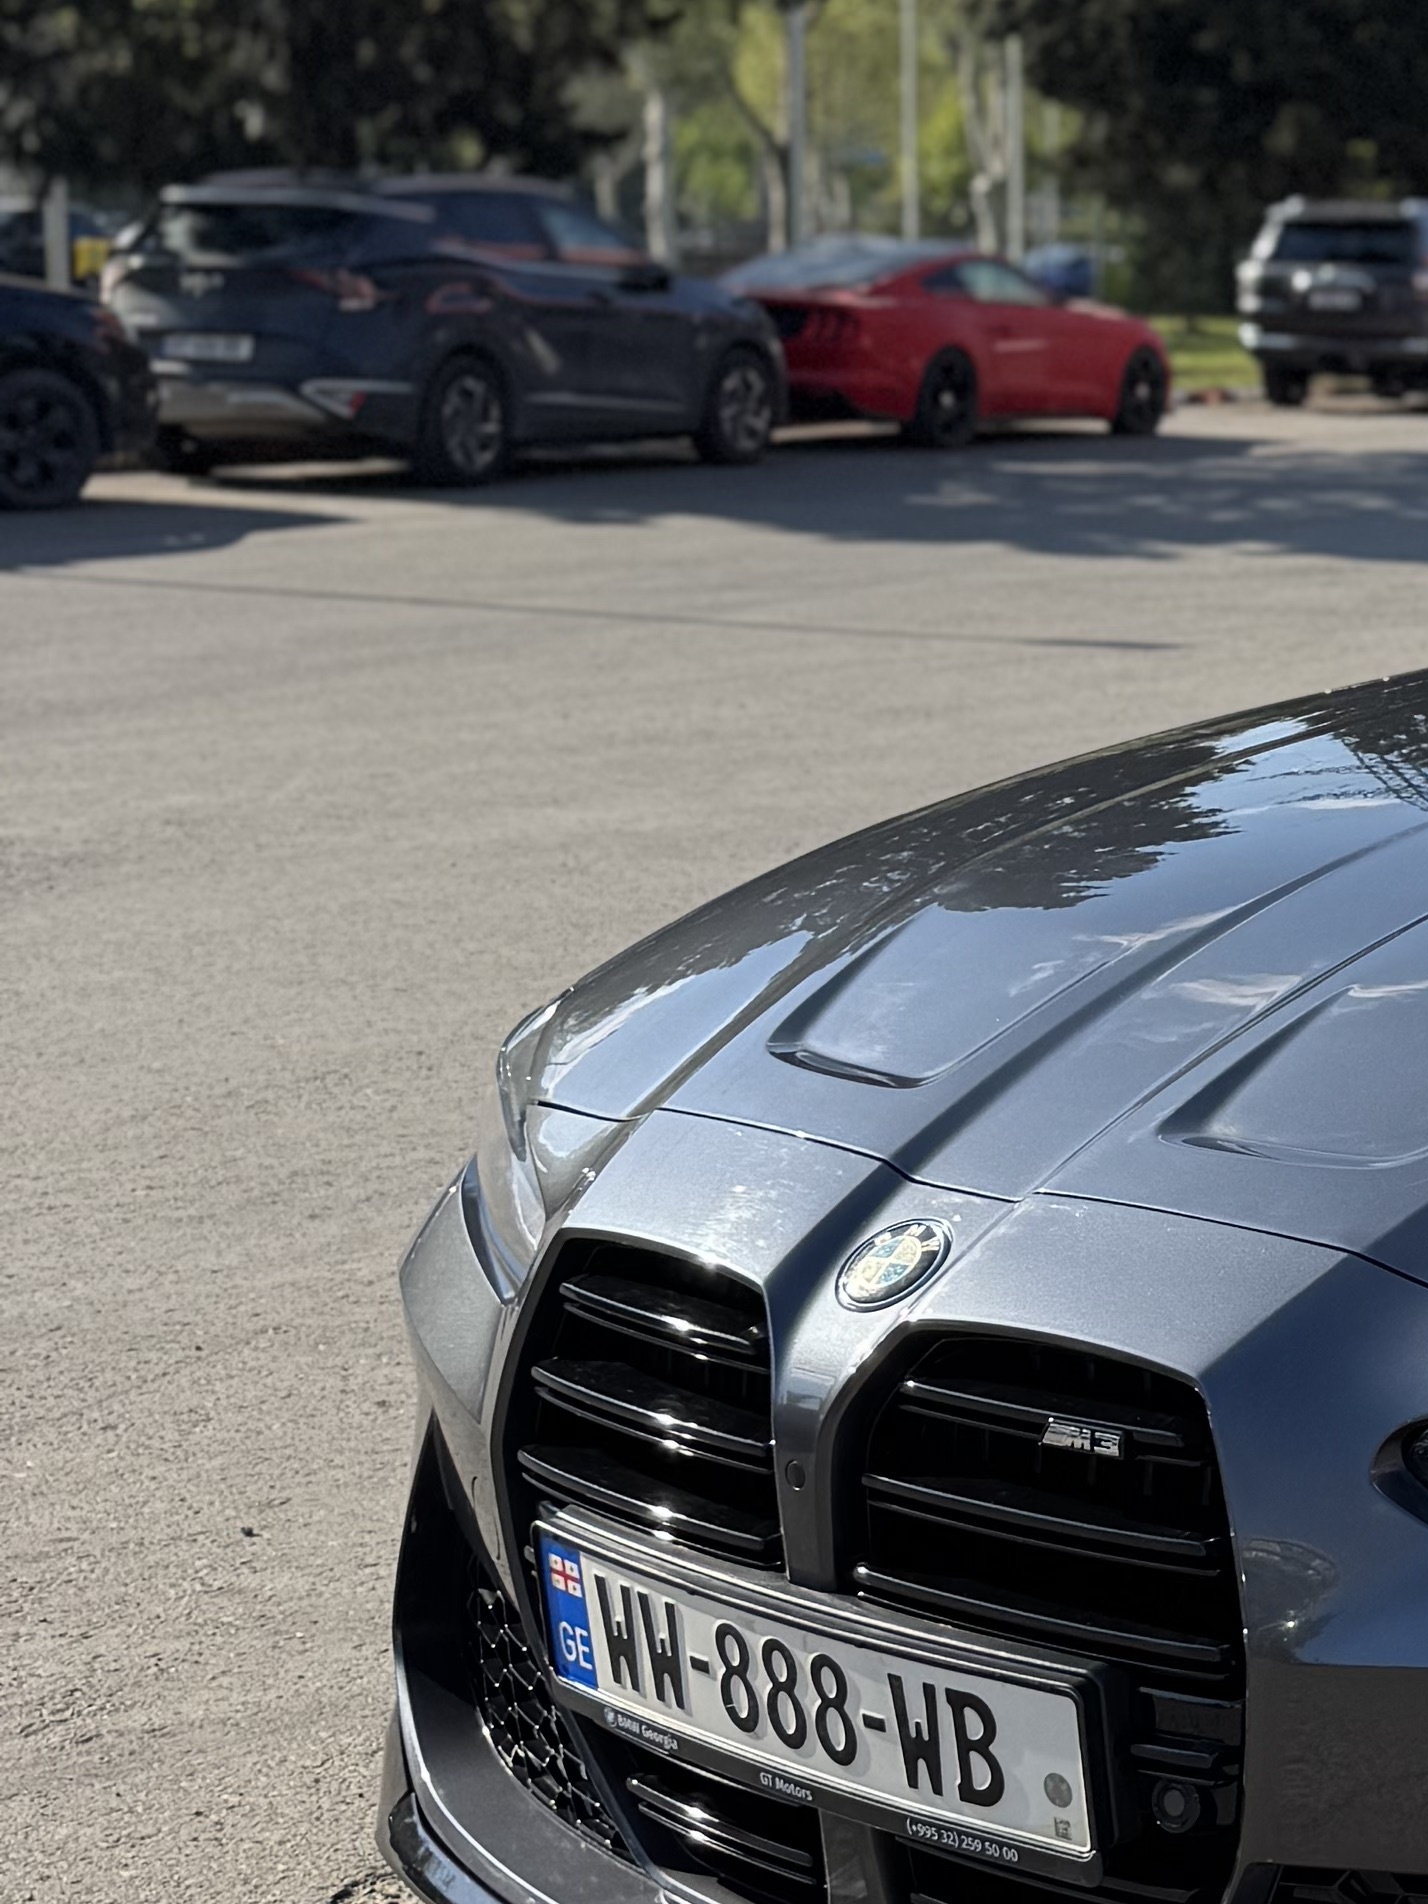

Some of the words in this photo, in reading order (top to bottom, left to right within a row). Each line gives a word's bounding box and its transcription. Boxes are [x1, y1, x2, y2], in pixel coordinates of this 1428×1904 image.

[558, 1620, 593, 1671] GE
[593, 1573, 1006, 1808] WW-888-WB
[641, 1725, 679, 1751] Georgia
[759, 1771, 773, 1788] GT
[775, 1776, 813, 1801] Motors
[940, 1830, 959, 1849] 32)
[961, 1835, 982, 1853] 259
[984, 1841, 1000, 1858] 50
[1002, 1846, 1019, 1863] 00
